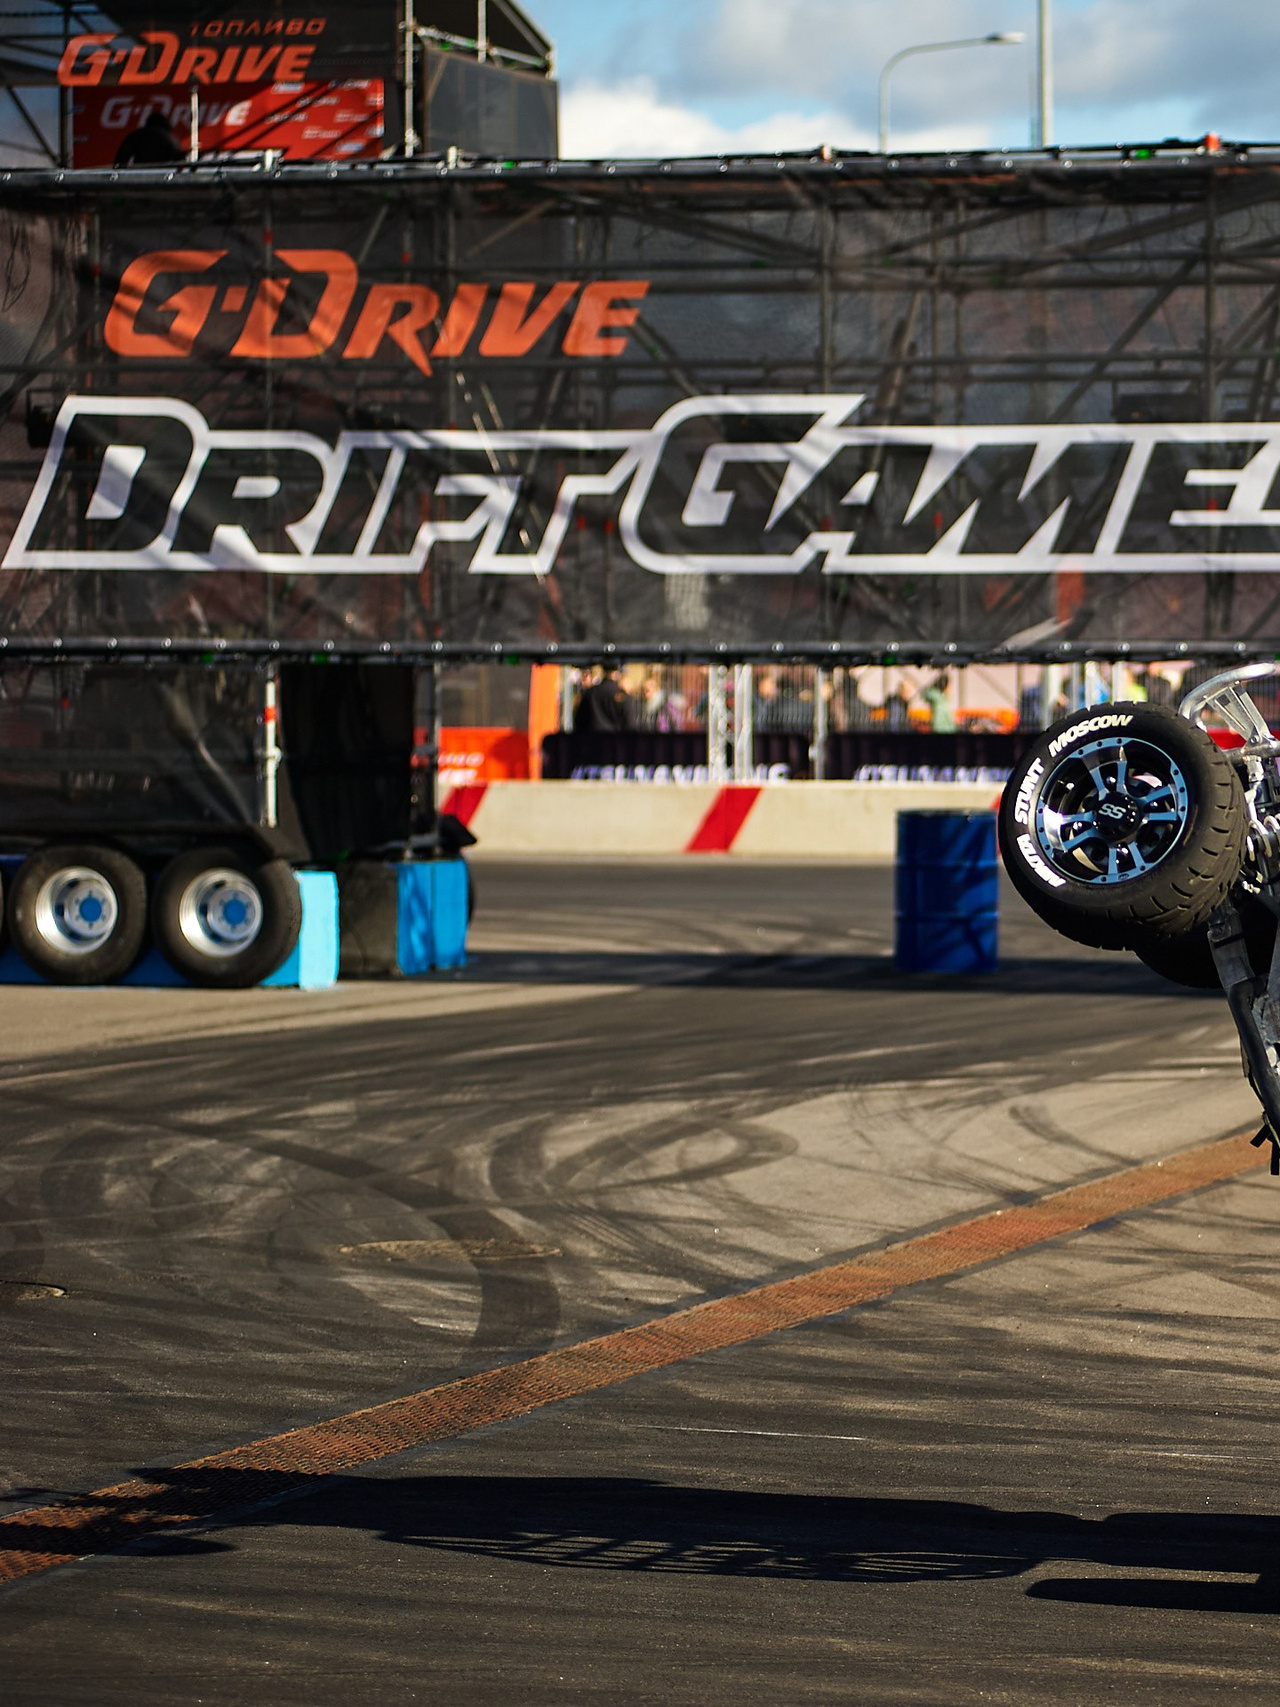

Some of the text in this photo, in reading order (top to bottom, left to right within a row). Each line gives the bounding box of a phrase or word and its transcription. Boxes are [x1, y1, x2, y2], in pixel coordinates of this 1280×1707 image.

[1, 395, 635, 575] DRIFT
[1014, 714, 1134, 888] NIKITA STUNT MOSCOW
